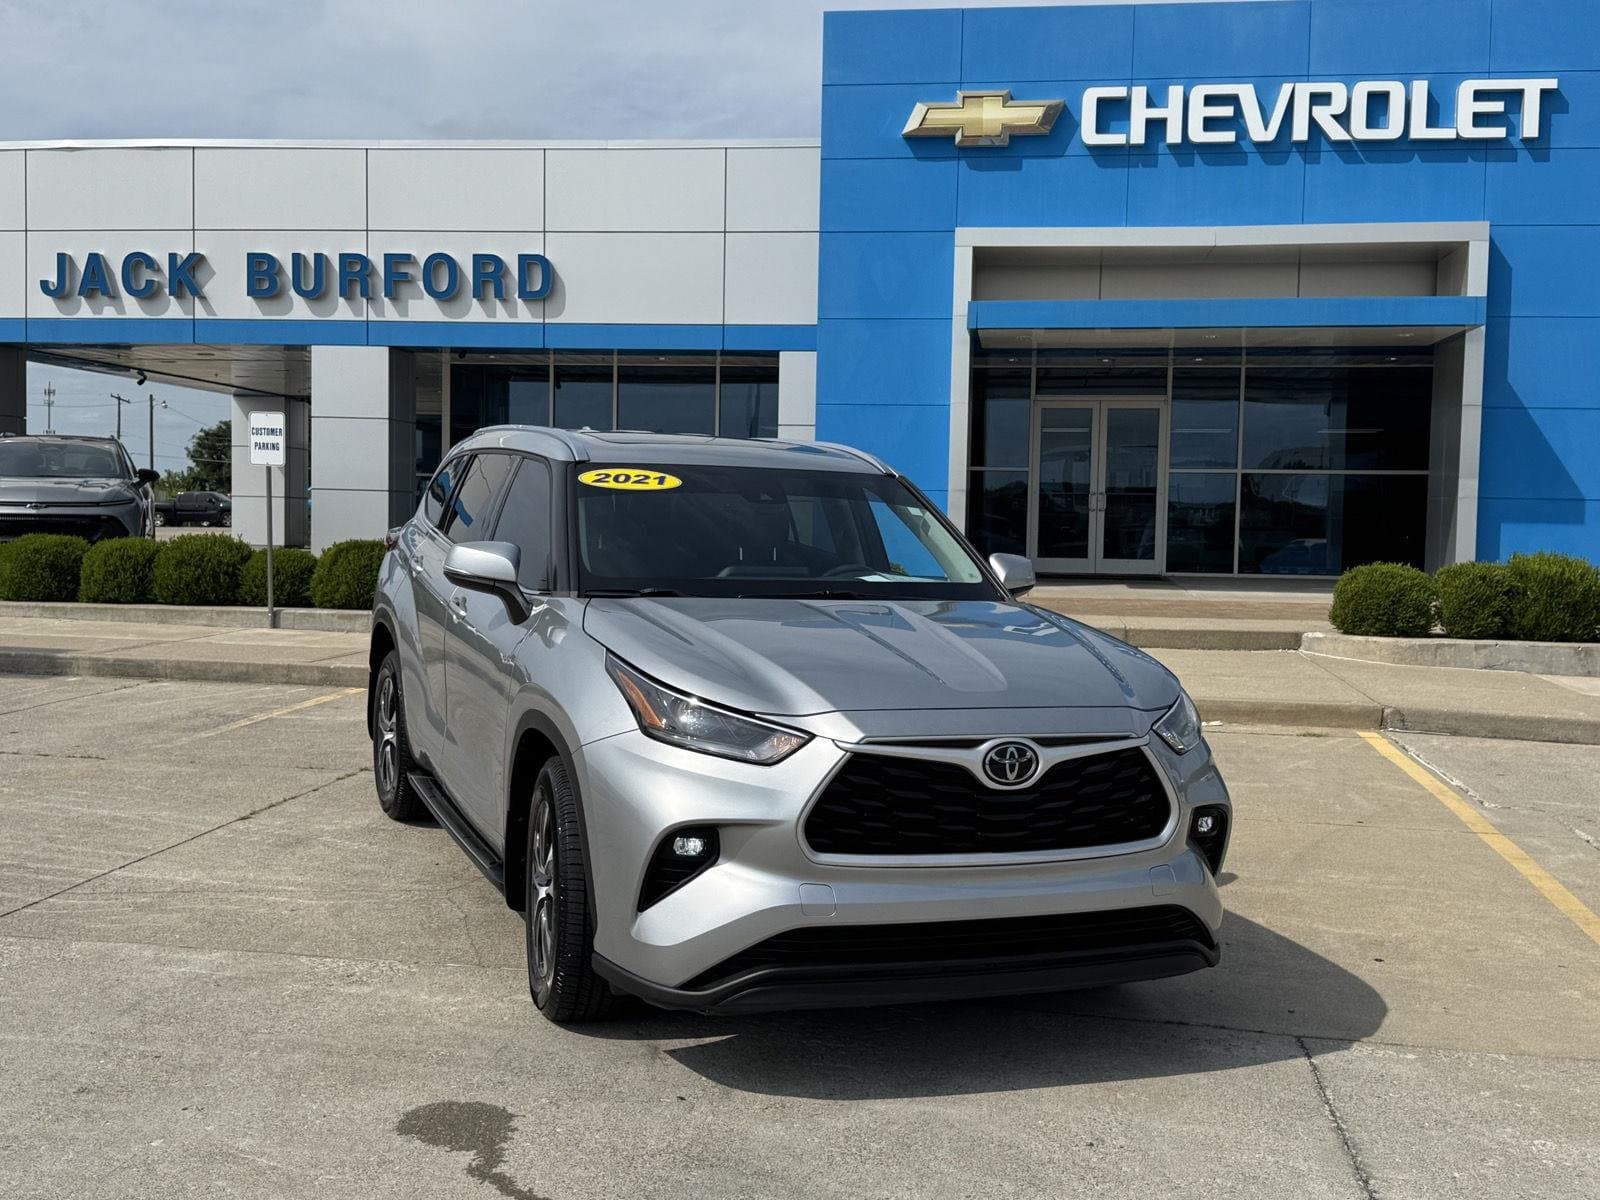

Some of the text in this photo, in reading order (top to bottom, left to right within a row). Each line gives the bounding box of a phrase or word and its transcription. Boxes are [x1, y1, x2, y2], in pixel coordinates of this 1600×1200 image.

[1081, 78, 1559, 146] CHEVROLET
[40, 252, 555, 300] JACK BURFORD
[251, 427, 283, 437] CUSTOMER
[254, 441, 280, 451] PARKING
[591, 473, 668, 486] 2021
